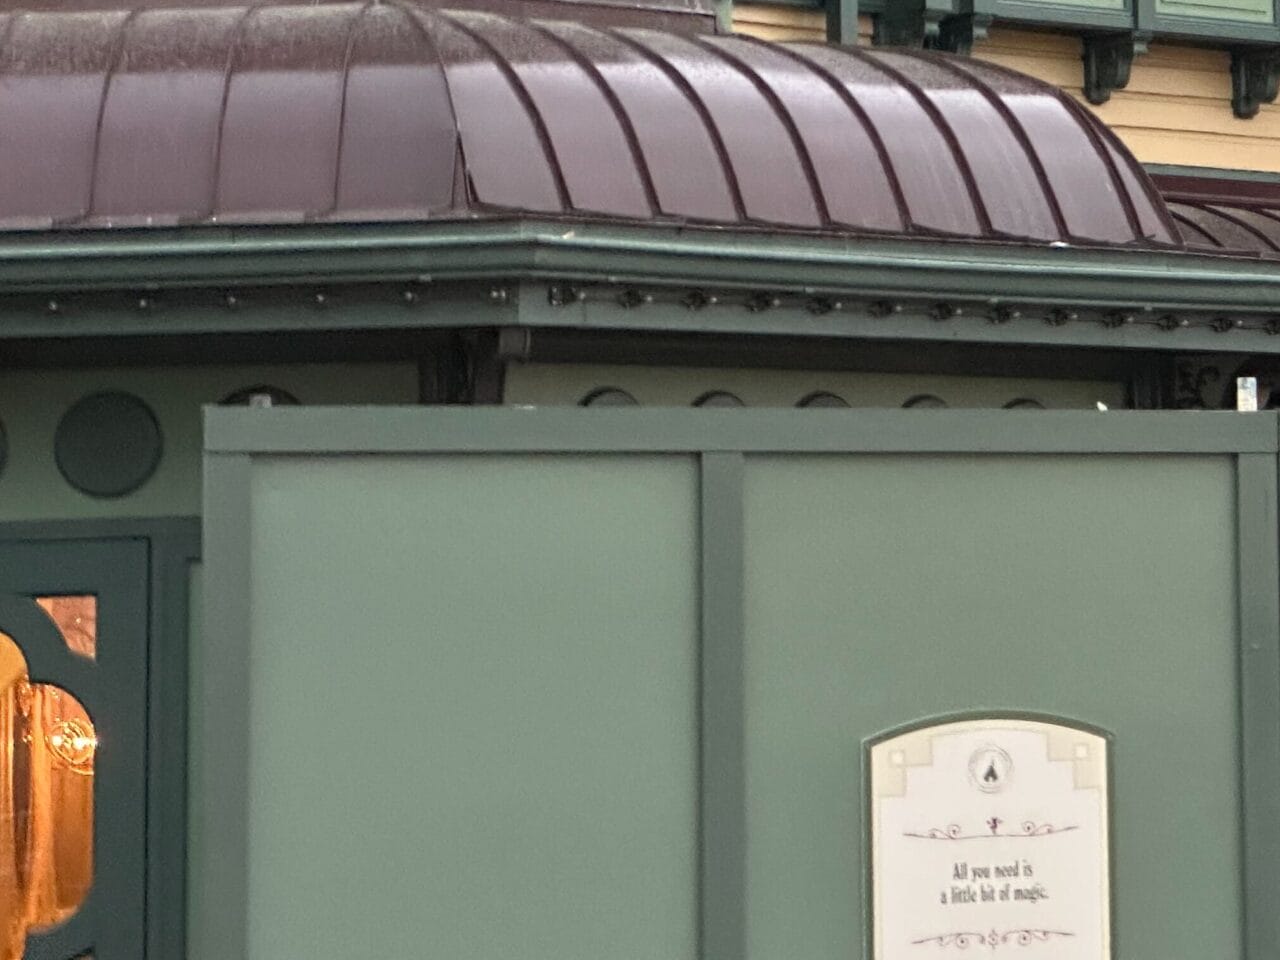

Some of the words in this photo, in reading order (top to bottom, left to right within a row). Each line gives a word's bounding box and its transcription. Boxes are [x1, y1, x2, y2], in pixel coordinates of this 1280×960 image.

[953, 861, 968, 880] All
[971, 867, 990, 883] you
[994, 859, 1019, 879] need
[1022, 858, 1033, 877] is
[941, 892, 947, 904] a
[951, 885, 977, 904] little
[981, 884, 995, 902] bit
[999, 883, 1010, 901] of
